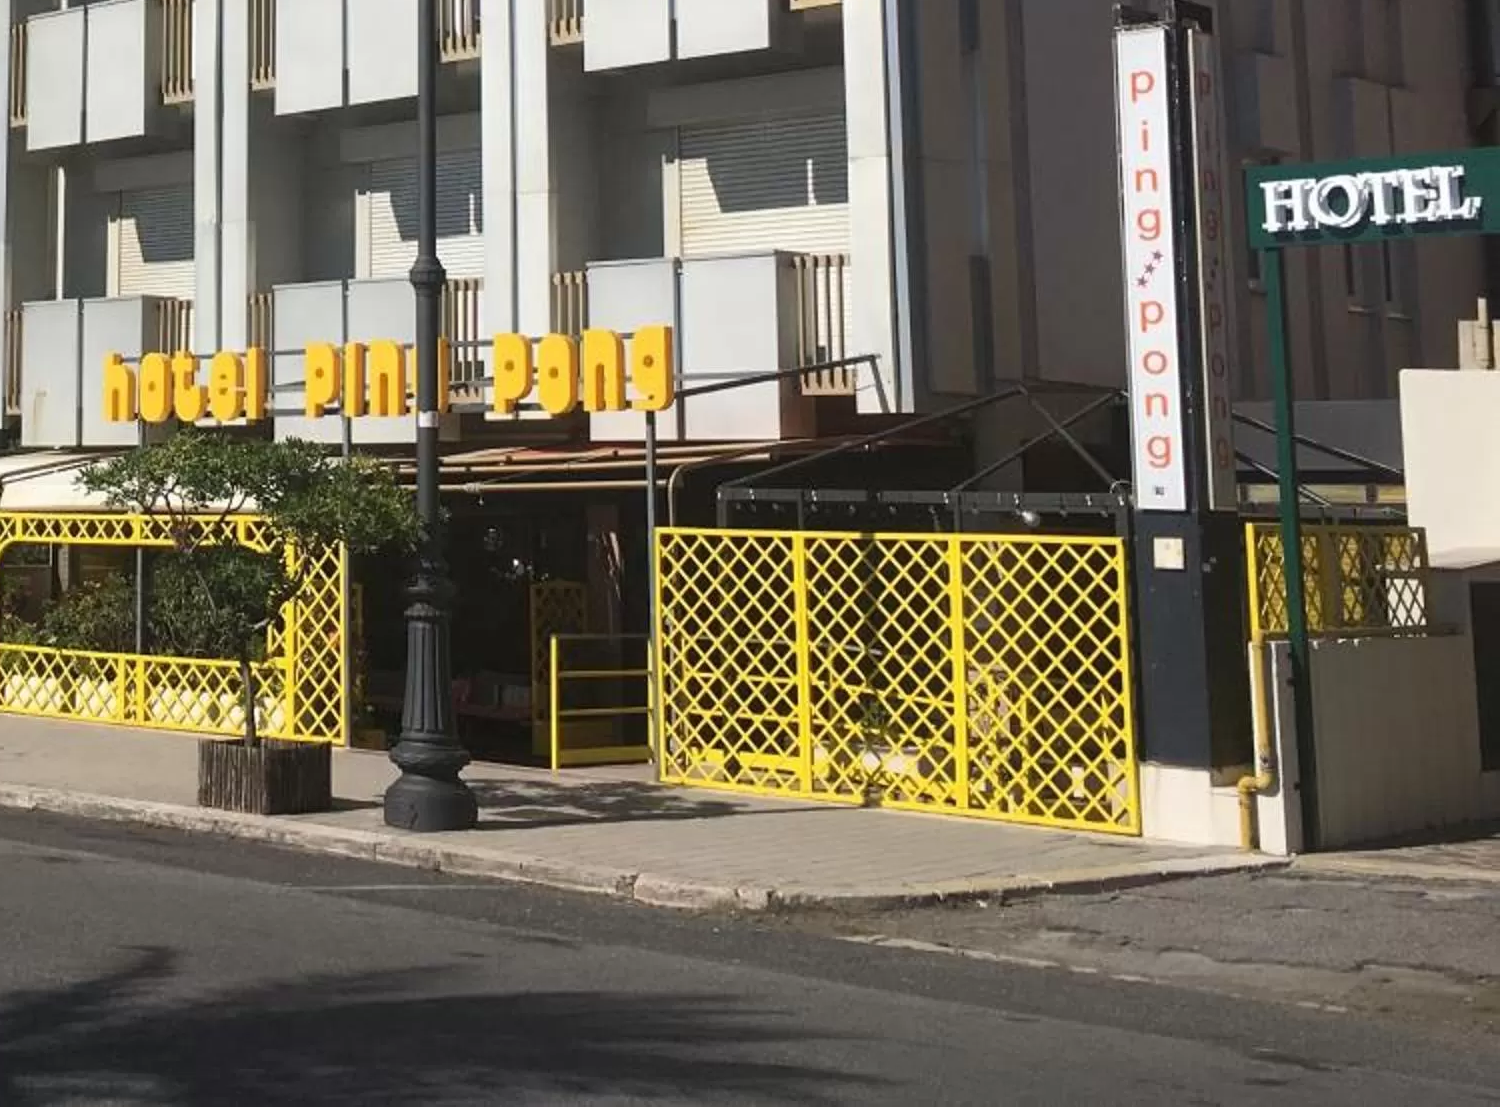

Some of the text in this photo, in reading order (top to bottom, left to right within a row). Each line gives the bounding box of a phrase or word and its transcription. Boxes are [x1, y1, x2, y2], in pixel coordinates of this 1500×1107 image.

[1260, 165, 1483, 233] HOTEL
[1129, 69, 1174, 469] ping pong
[102, 326, 676, 424] hotel pin pong
